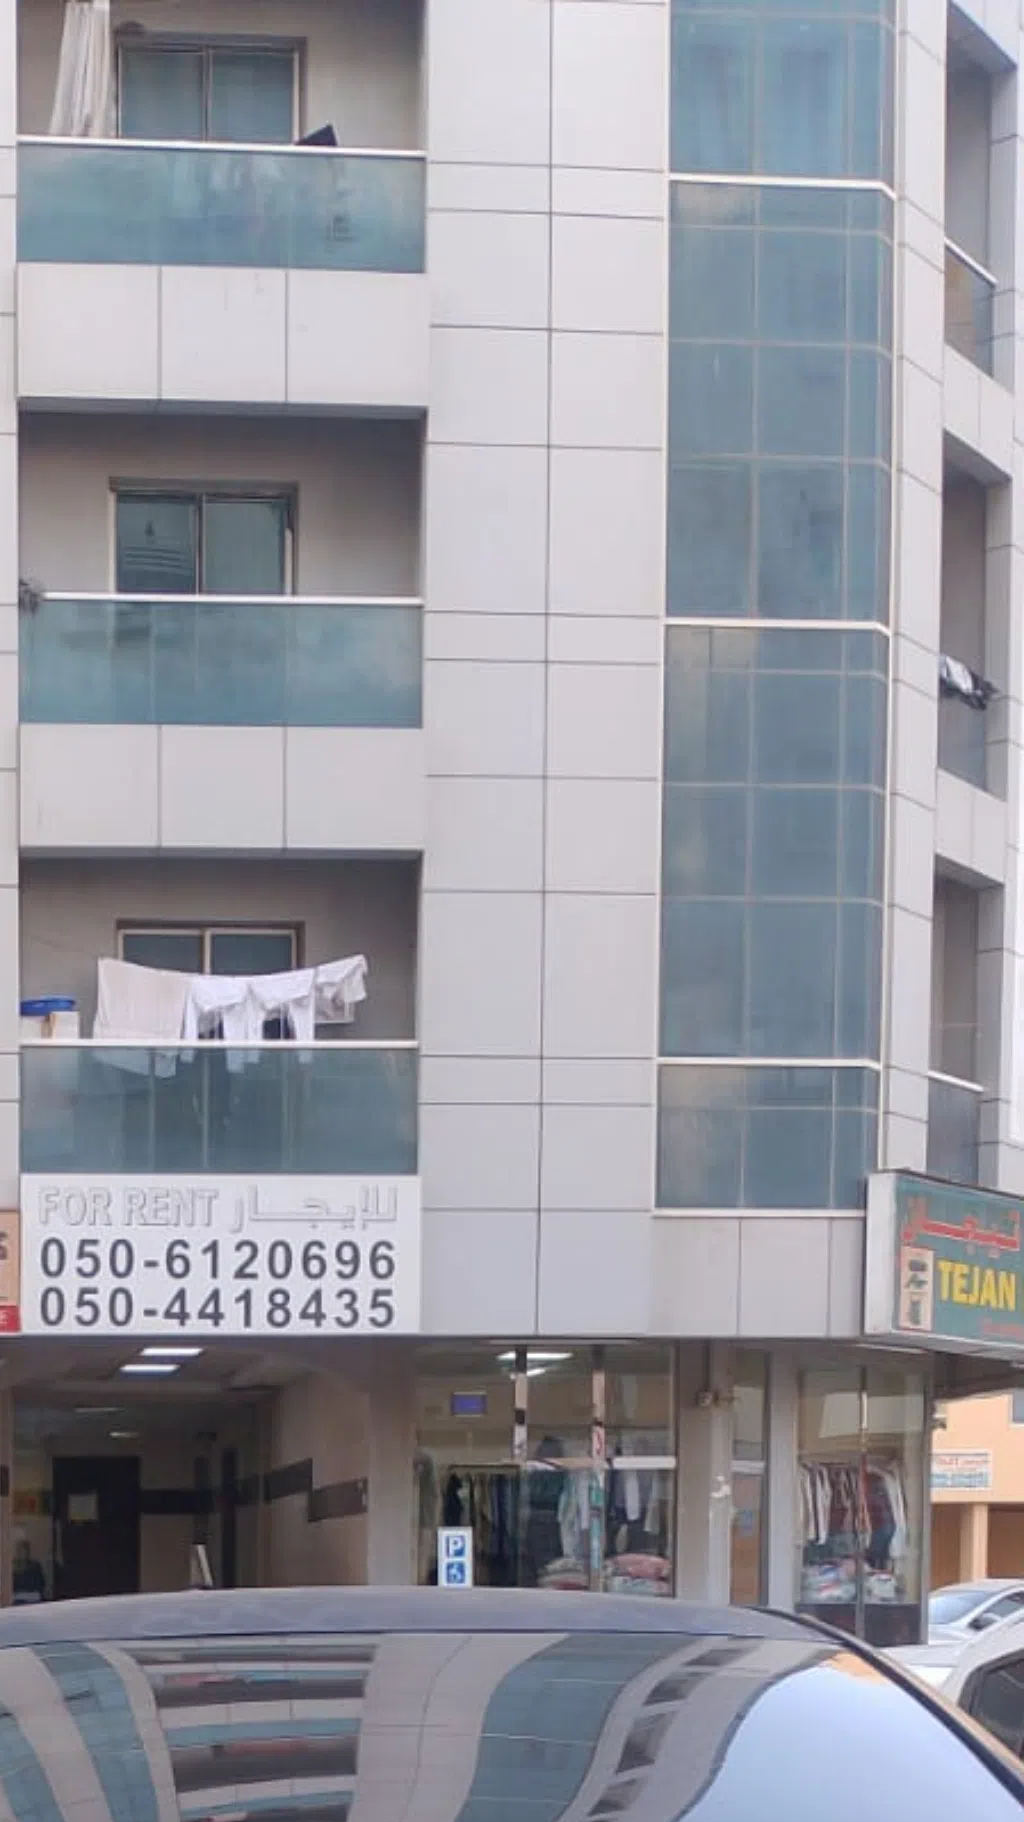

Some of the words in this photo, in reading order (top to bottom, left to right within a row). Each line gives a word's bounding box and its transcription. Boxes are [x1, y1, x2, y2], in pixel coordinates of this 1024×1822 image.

[38, 1187, 111, 1226] FOR
[123, 1188, 219, 1227] RENT
[40, 1238, 396, 1280] 050-6120696
[937, 1260, 1016, 1312] TEJAN
[40, 1287, 396, 1329] 050-4418435
